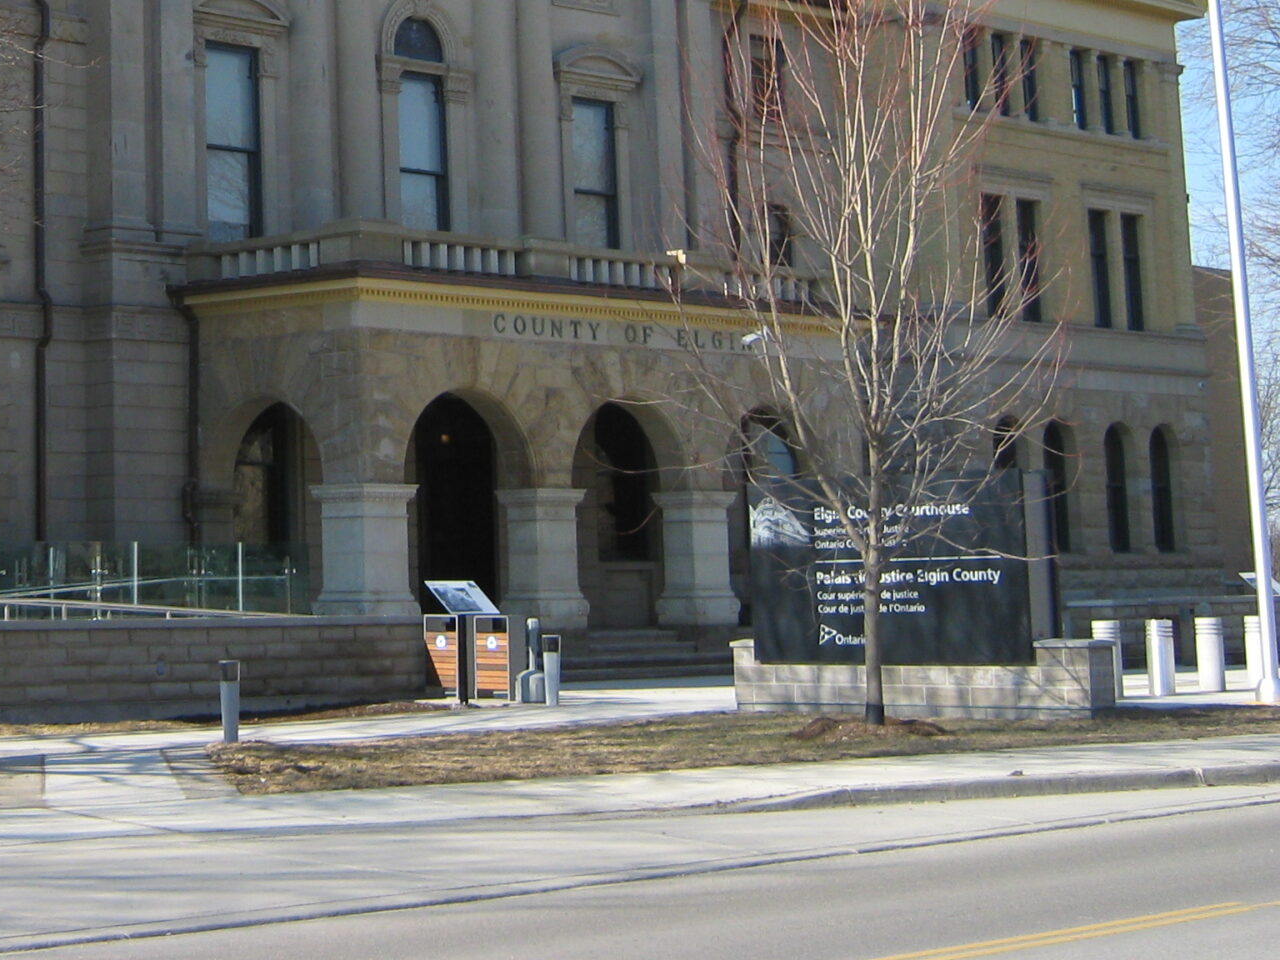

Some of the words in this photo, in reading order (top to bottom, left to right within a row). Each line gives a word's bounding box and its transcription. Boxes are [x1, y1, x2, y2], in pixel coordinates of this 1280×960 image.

[494, 314, 600, 341] COUNTY
[624, 324, 653, 345] OF
[813, 506, 842, 523] Elgi
[814, 539, 845, 549] Ontario
[816, 570, 851, 585] Palais
[916, 568, 949, 586] Elgin
[952, 567, 1001, 585] County
[817, 590, 836, 600] Cour
[880, 589, 891, 600] de
[892, 589, 919, 601] justice
[817, 604, 837, 614] Cour
[838, 603, 849, 614] de
[889, 602, 926, 614] l'Ontario
[835, 633, 867, 646] Ontari
